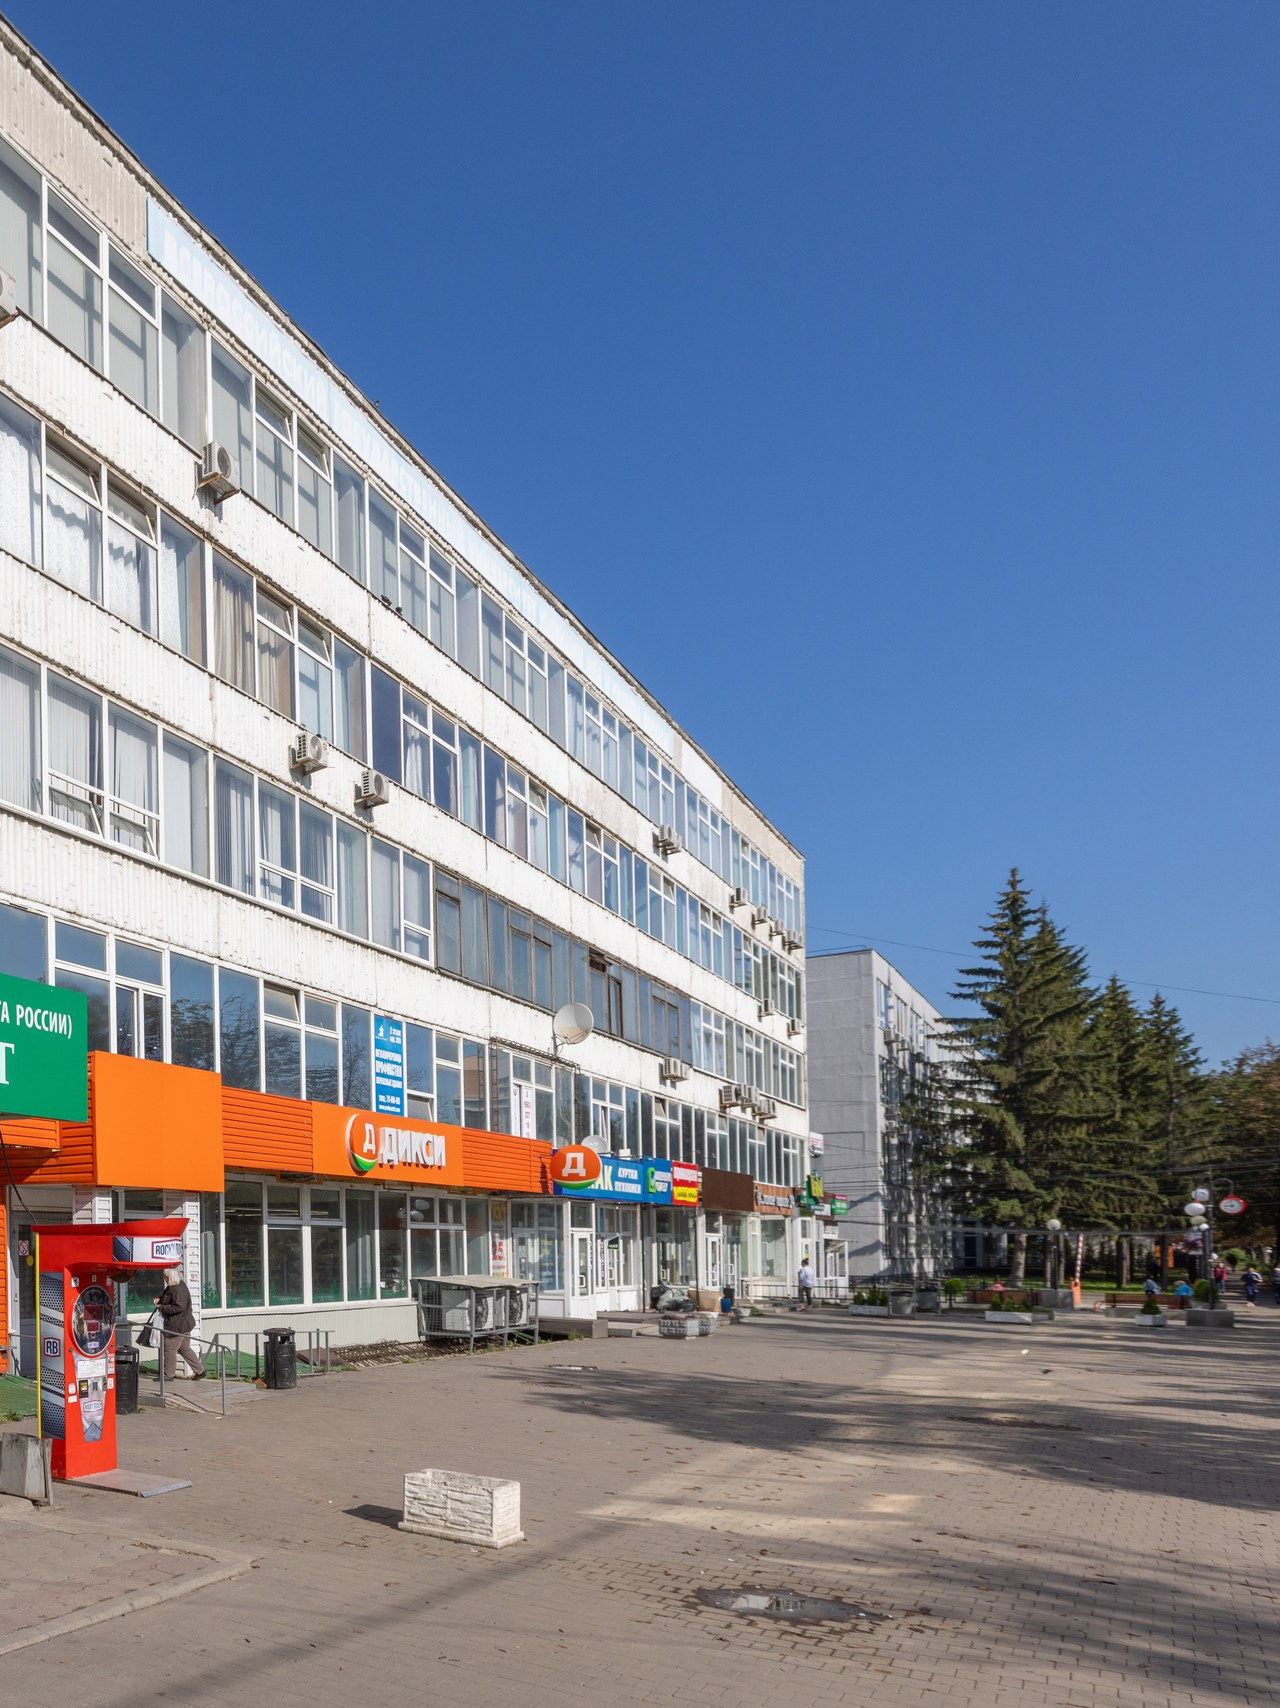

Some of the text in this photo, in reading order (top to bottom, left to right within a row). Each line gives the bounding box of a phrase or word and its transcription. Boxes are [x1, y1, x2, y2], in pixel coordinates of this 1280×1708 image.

[16, 1004, 73, 1040] РОССИИ)
[363, 1122, 376, 1155] Д
[378, 1127, 446, 1167] ДИКСИ
[561, 1152, 586, 1177] Д
[46, 1341, 59, 1355] RB
